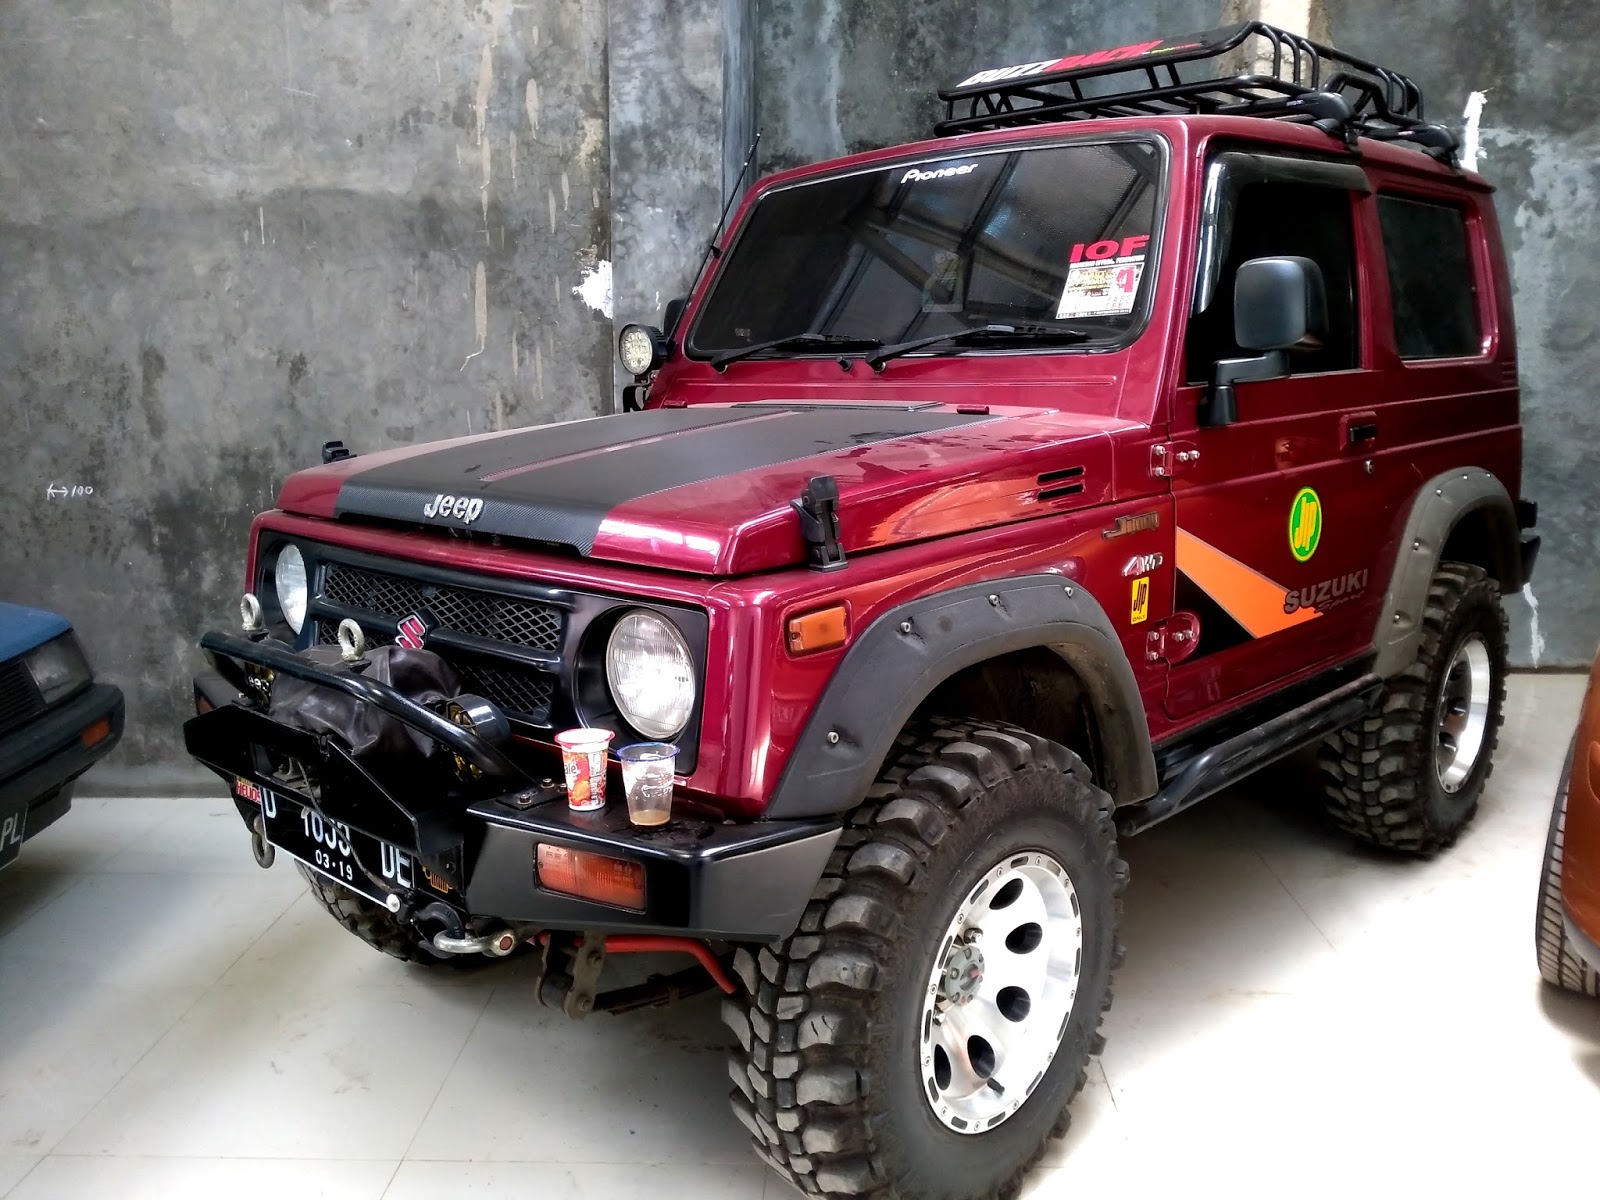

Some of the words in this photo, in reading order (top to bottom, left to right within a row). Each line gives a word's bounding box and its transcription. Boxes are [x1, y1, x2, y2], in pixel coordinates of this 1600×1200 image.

[900, 164, 979, 184] Pioneer
[1069, 235, 1150, 263] IOF
[71, 485, 94, 497] 100
[423, 494, 484, 525] Jeep
[1284, 568, 1369, 613] SUZUKI
